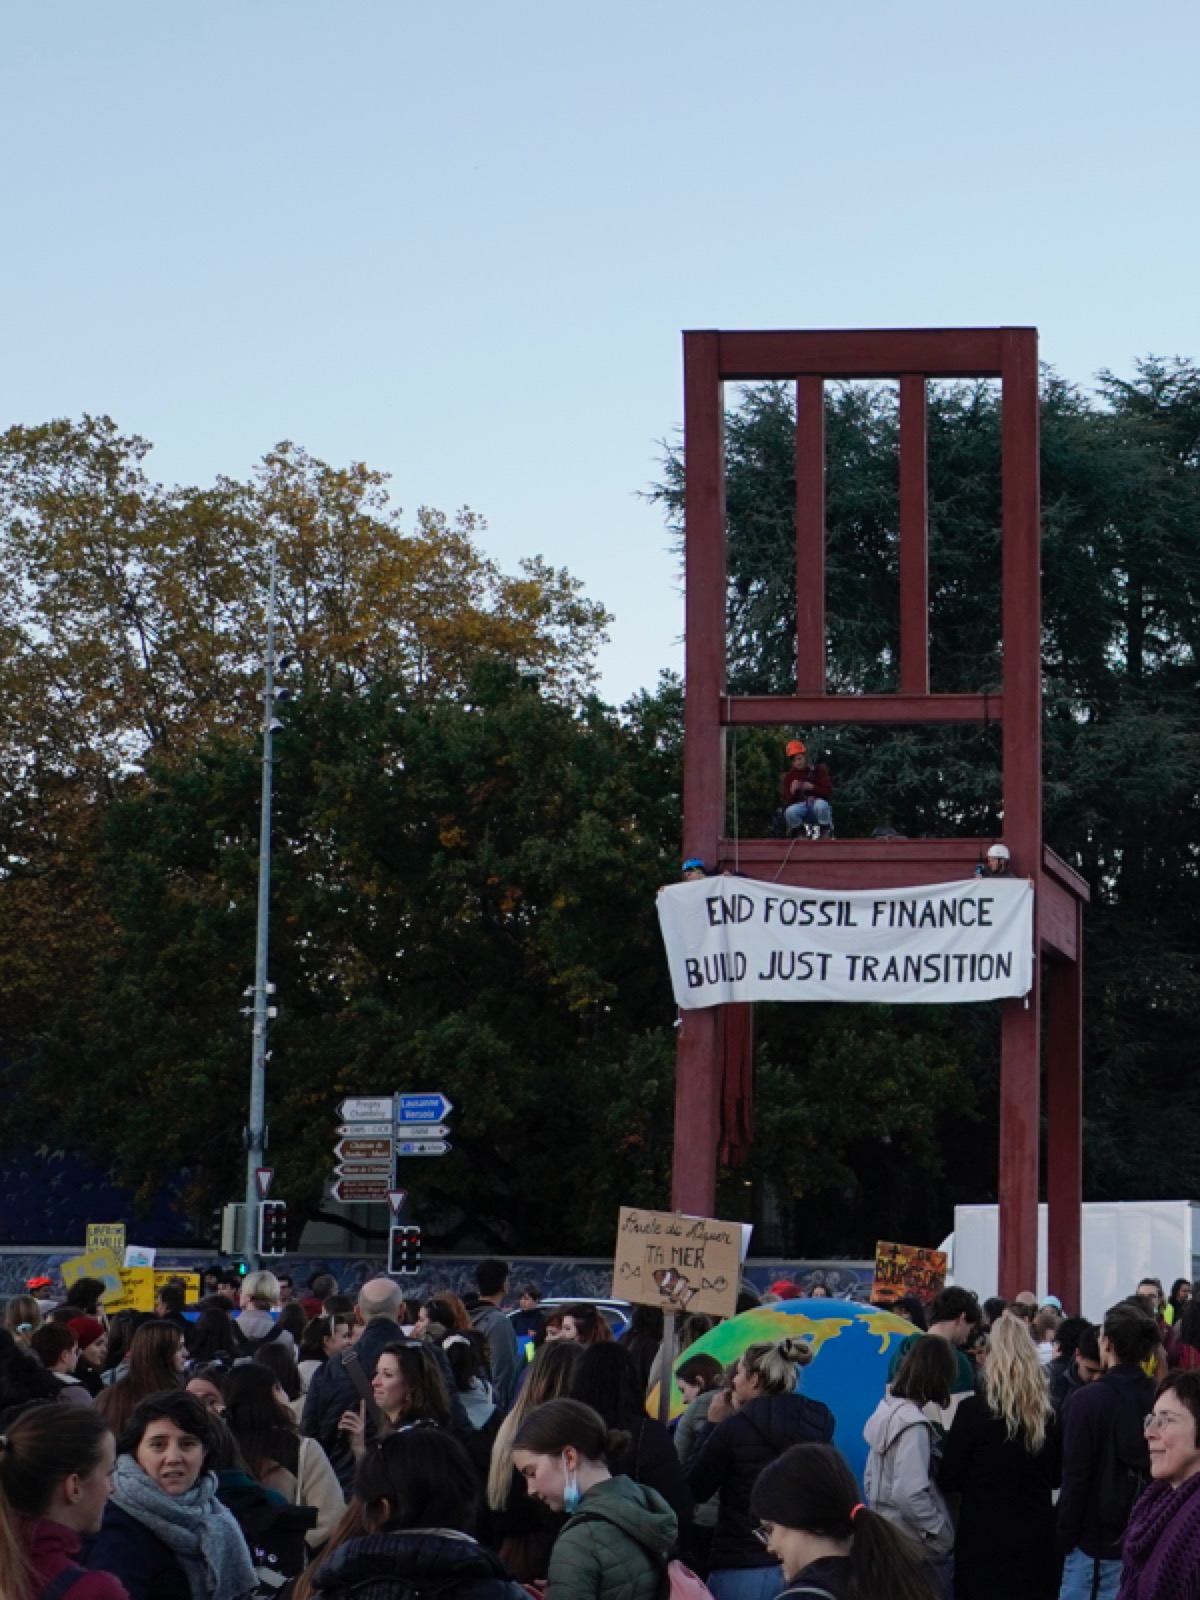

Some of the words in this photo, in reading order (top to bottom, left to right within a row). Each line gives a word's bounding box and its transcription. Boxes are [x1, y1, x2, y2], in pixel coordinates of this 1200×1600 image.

[706, 893, 755, 926] END
[763, 897, 859, 927] FOSSIL
[871, 897, 995, 928] FINANCE
[685, 951, 748, 988] BUILD
[757, 950, 833, 981] JUST
[846, 951, 1013, 983] TRANSITION
[401, 1099, 439, 1108] Lausanne
[646, 1244, 664, 1265] TA
[671, 1246, 705, 1269] MER
